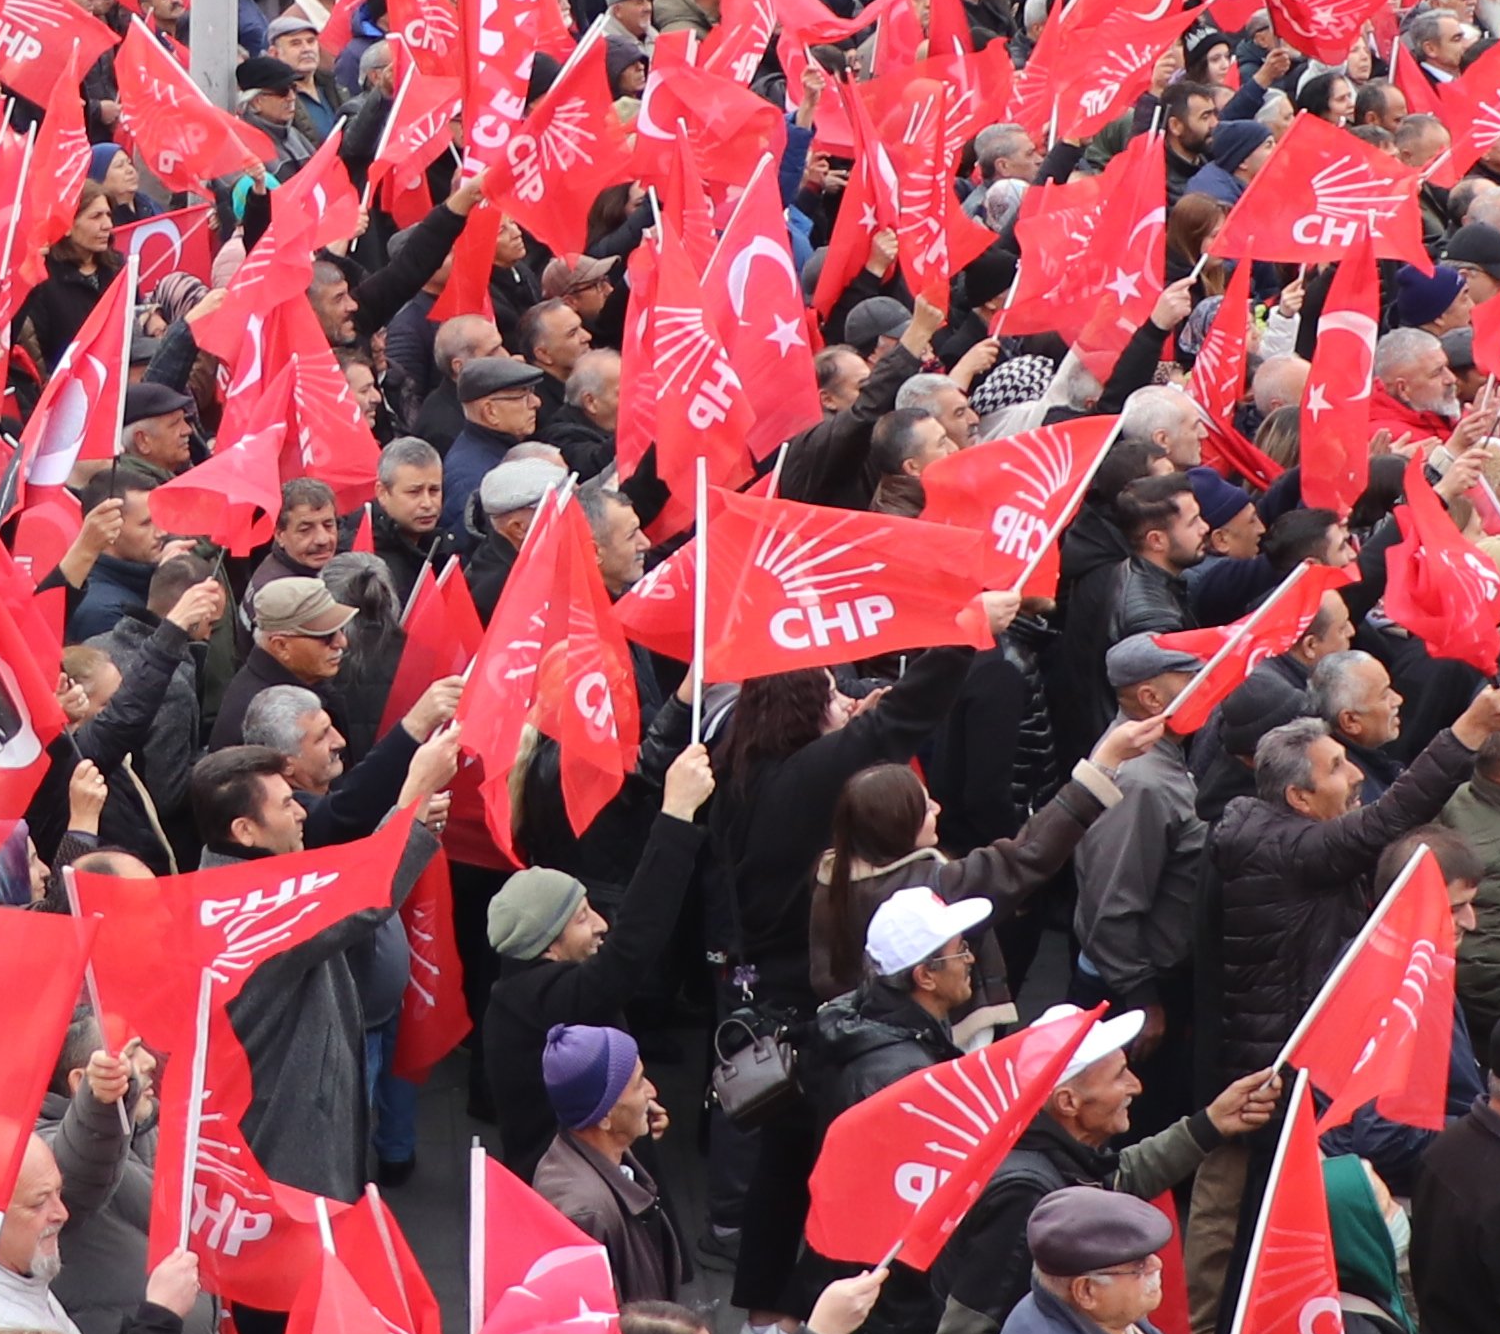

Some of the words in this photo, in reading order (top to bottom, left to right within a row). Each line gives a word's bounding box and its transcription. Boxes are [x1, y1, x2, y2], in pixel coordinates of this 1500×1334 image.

[408, 19, 436, 48] CH
[509, 134, 542, 200] CHP
[1292, 214, 1379, 248] CH
[769, 598, 895, 649] CHP
[573, 669, 618, 739] CH
[191, 1183, 272, 1253] HP
